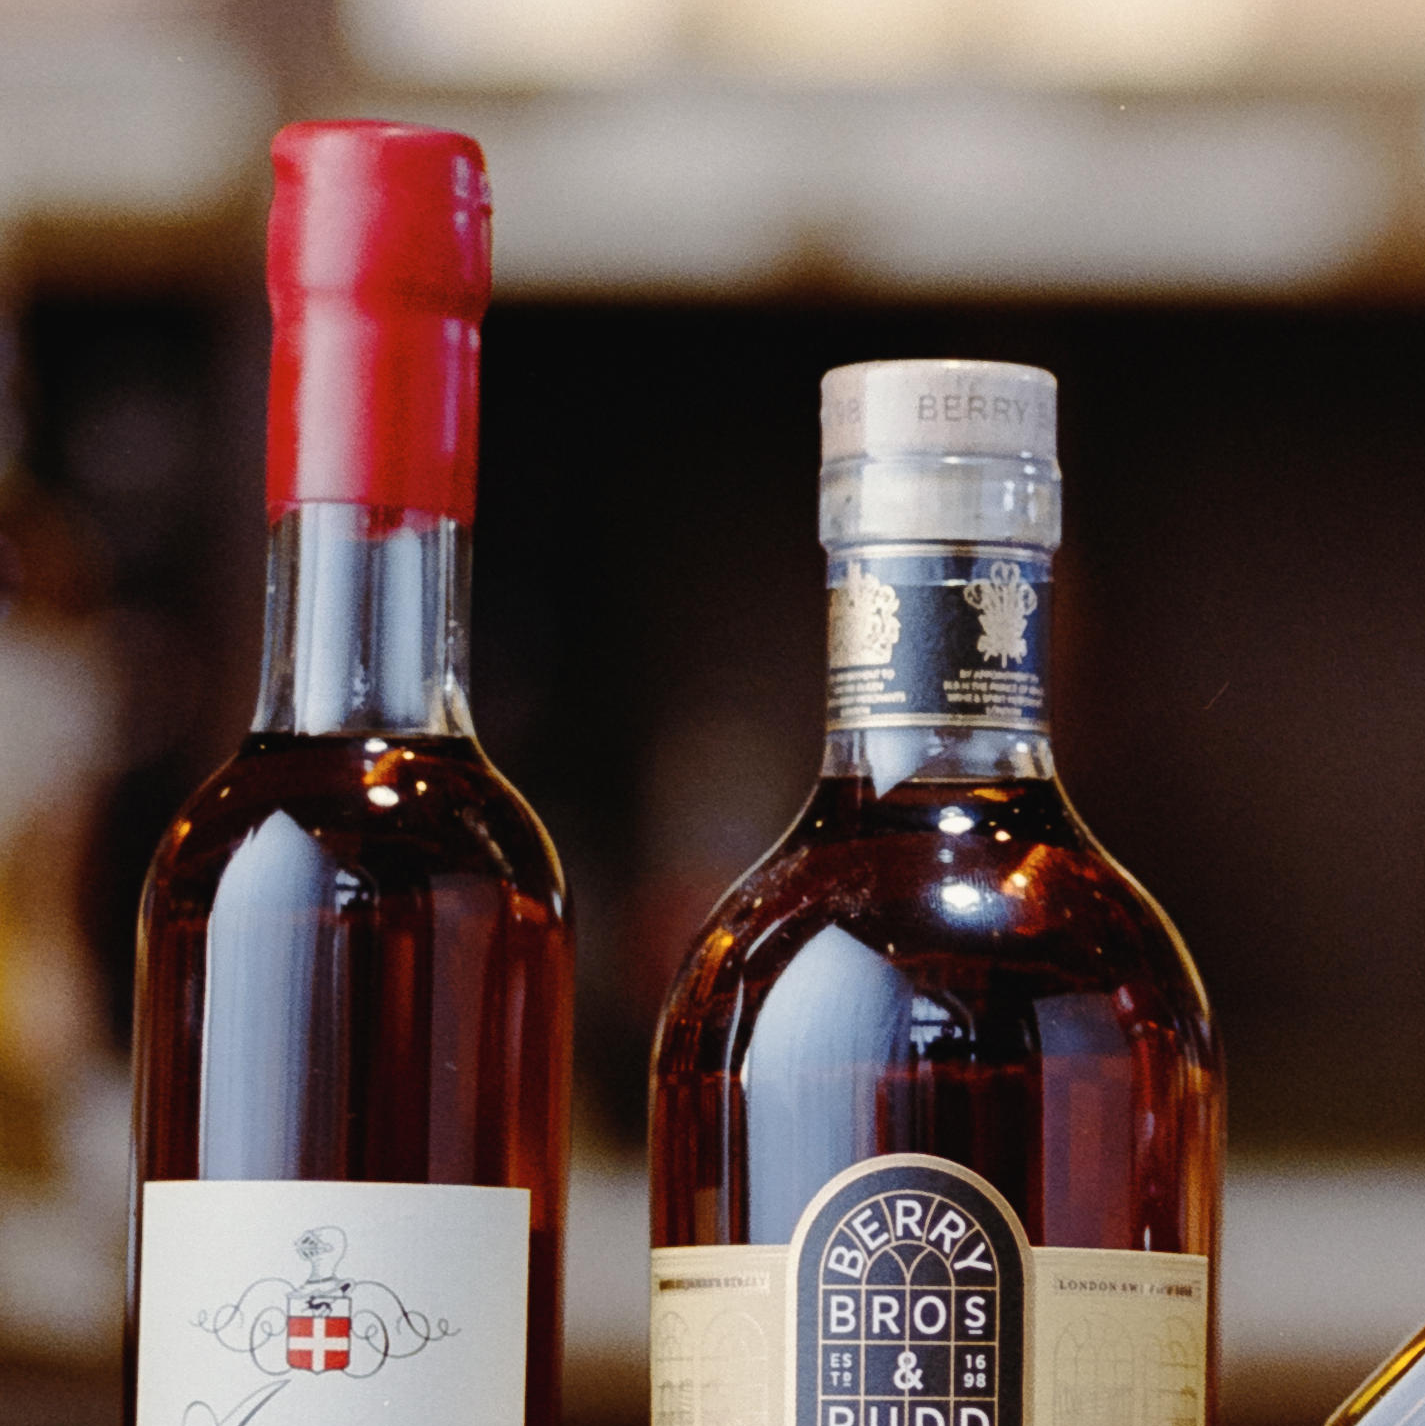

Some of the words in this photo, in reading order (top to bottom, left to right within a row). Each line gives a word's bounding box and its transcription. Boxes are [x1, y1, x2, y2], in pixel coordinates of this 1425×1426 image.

[916, 393, 1030, 424] BERRY
[828, 1198, 993, 1279] BERRY
[828, 1294, 987, 1336] BROS
[892, 1349, 925, 1391] &
